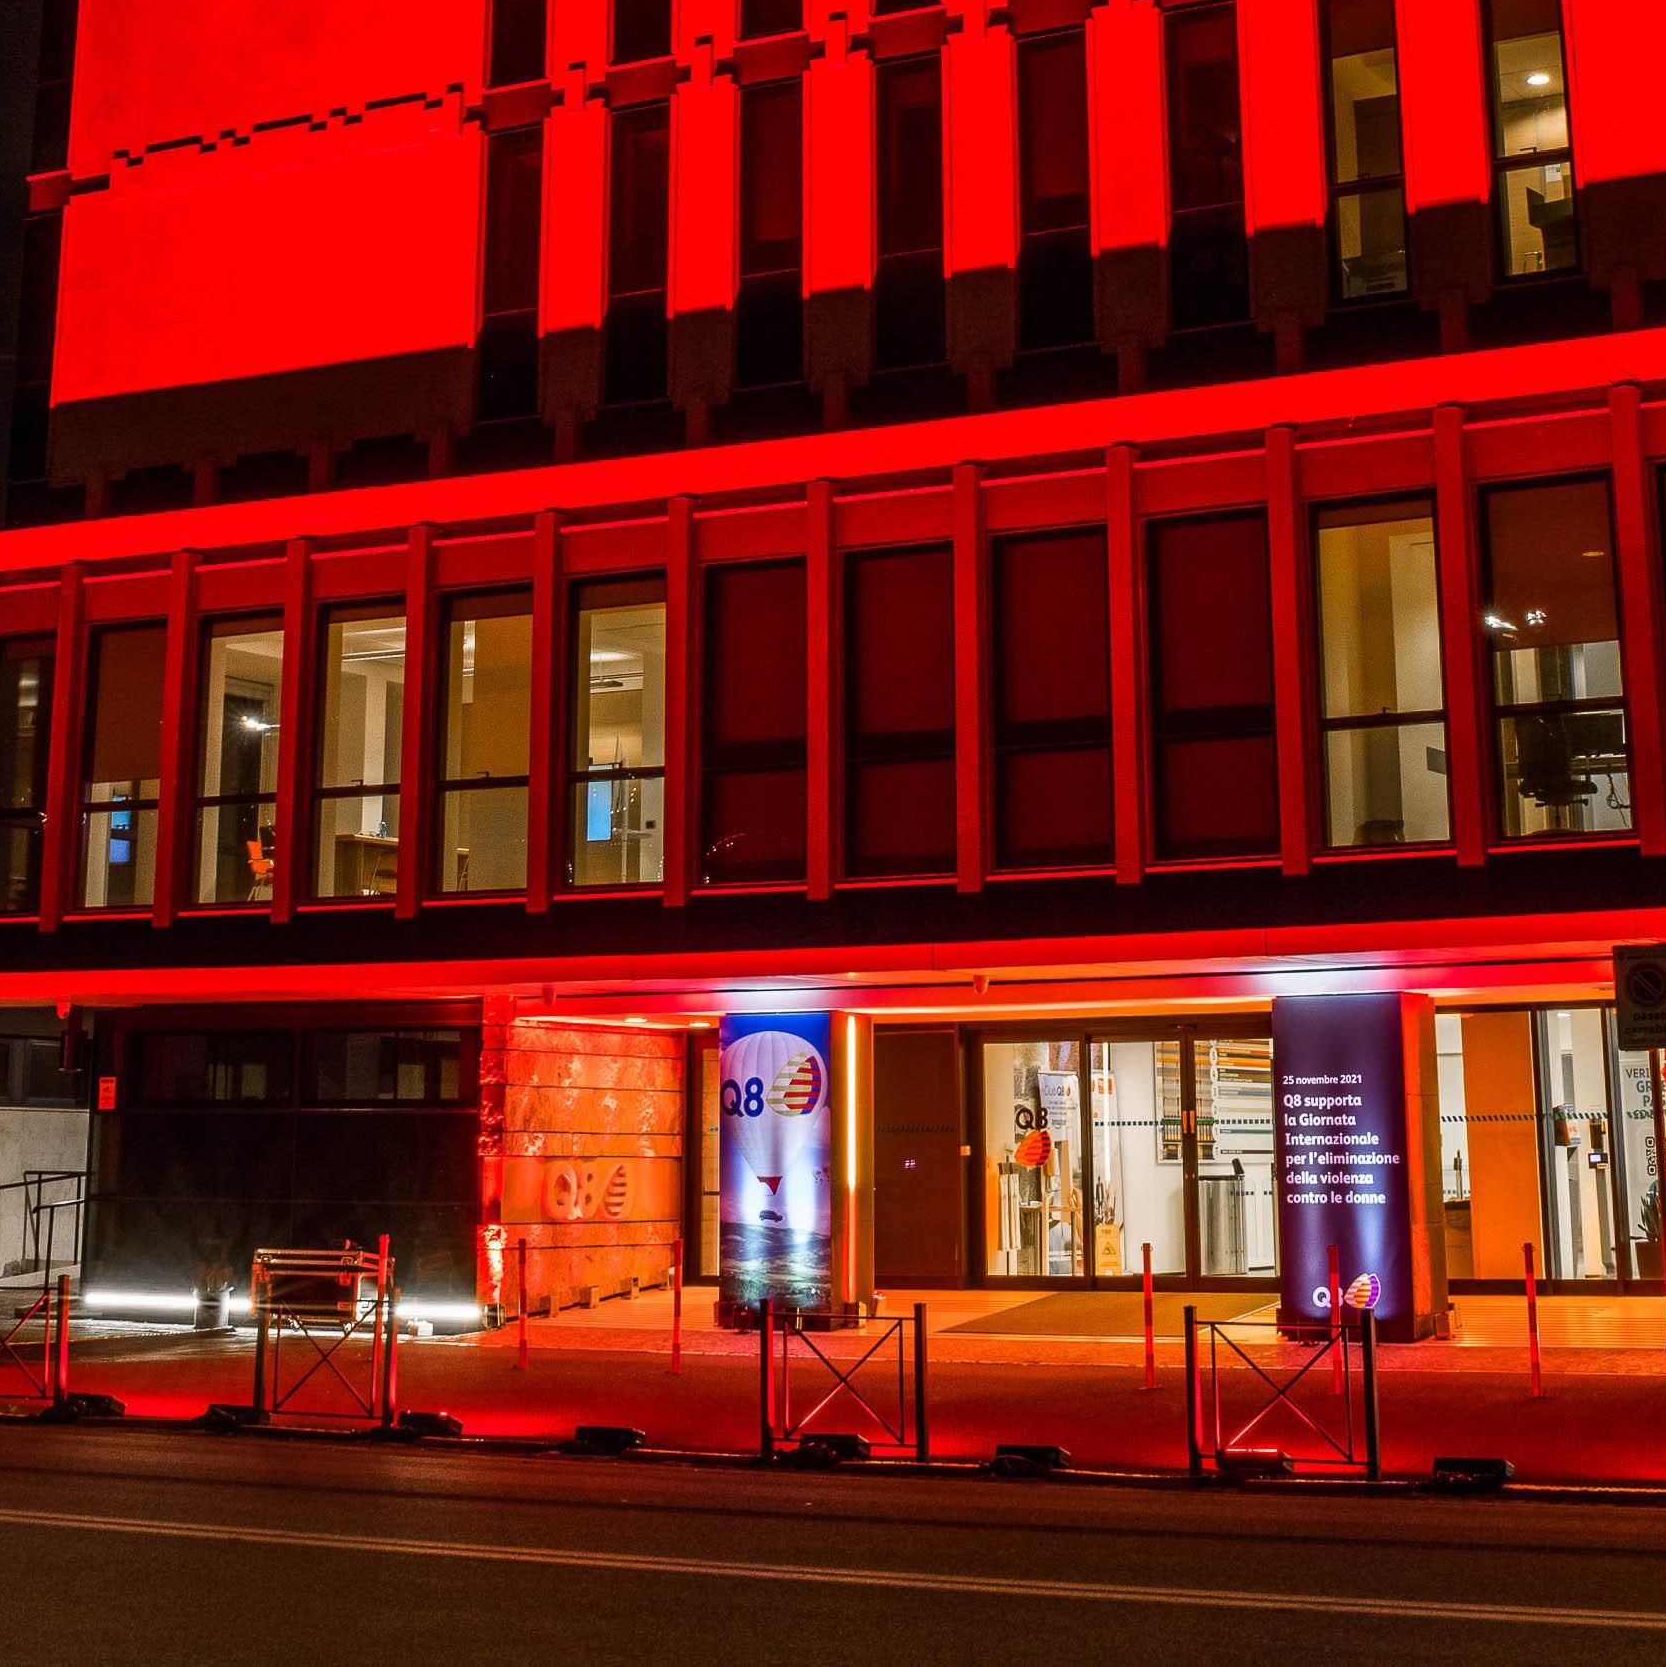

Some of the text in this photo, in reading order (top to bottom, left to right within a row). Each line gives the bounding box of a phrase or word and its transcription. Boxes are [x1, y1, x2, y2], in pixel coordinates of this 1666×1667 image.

[1283, 1074, 1362, 1084] 25 novembre 2021
[1625, 1068, 1650, 1078] VERI
[719, 1076, 764, 1117] Q8
[1284, 1094, 1362, 1110] Q8 supporta
[1015, 1107, 1049, 1129] Q8
[1284, 1113, 1357, 1126] la Giornata
[1285, 1132, 1379, 1145] Internazionale
[1285, 1152, 1400, 1168] per l'eliminazione
[1286, 1171, 1374, 1184] della violenza
[547, 1161, 598, 1220] Q8
[1286, 1190, 1386, 1204] contro le donne
